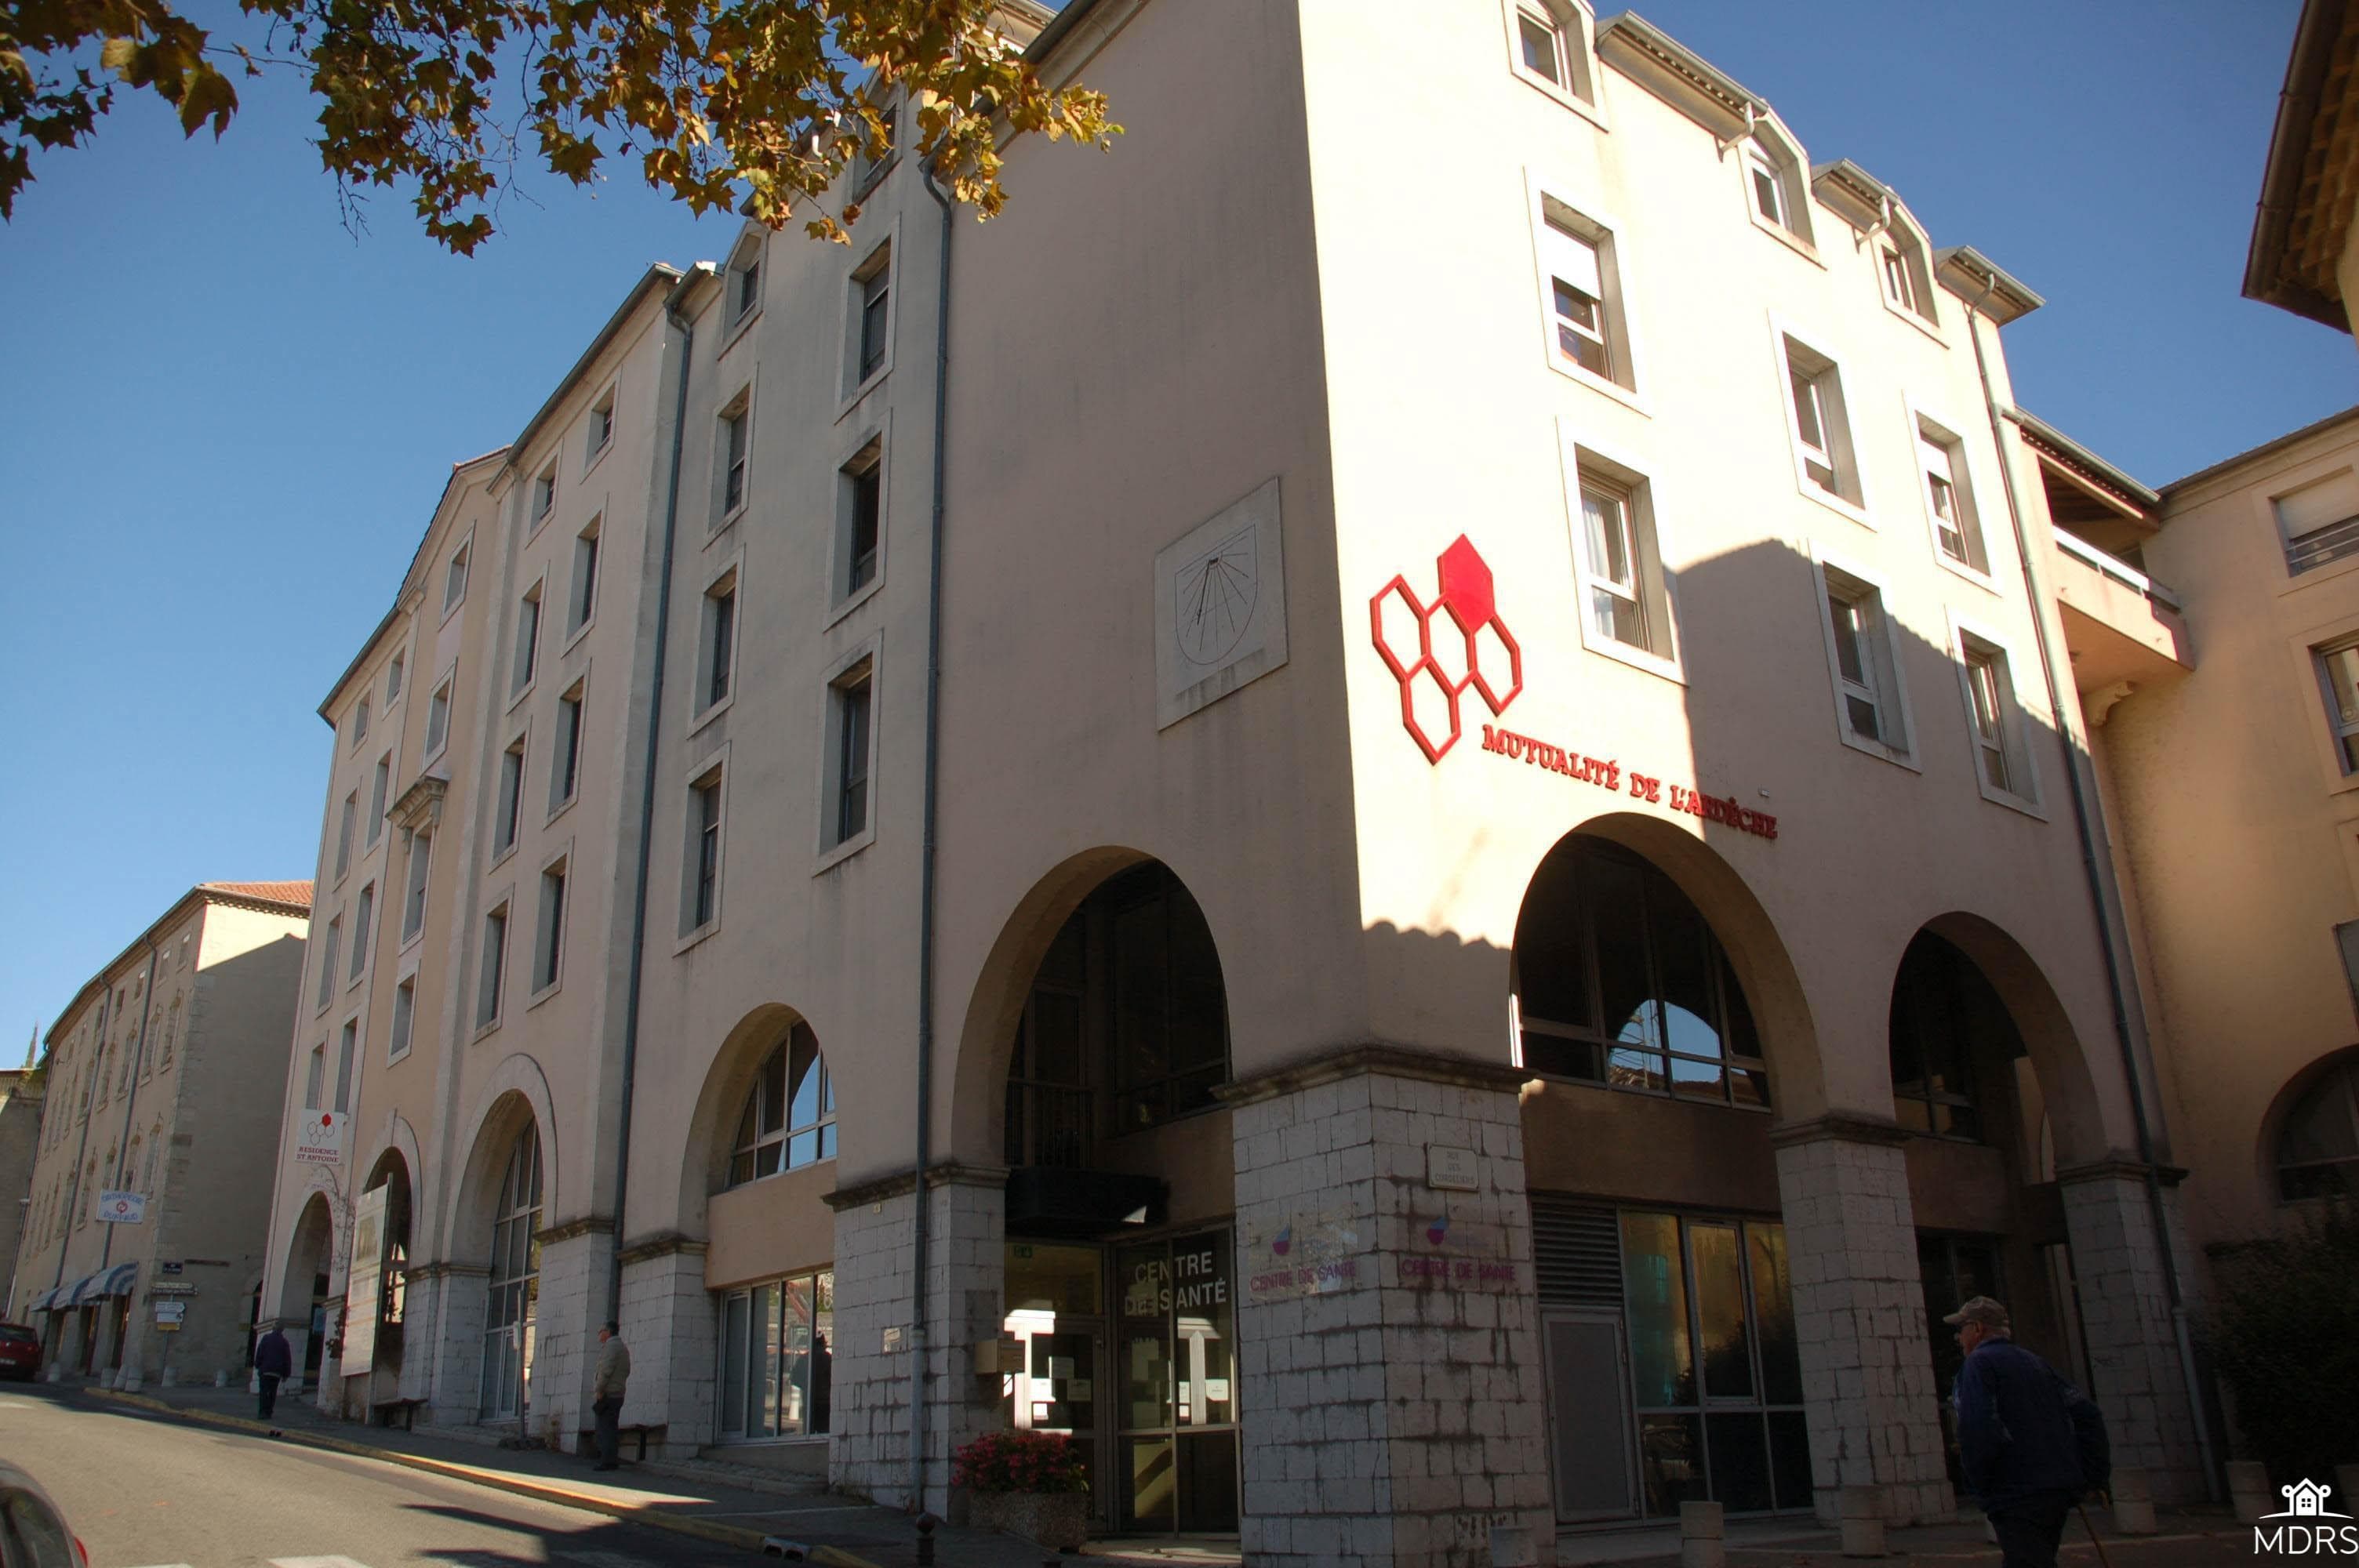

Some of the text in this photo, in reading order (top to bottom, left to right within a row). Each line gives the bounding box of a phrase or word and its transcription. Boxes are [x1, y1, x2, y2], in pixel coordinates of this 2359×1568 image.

[1481, 724, 1779, 840] MUTUALITÉ DE L'ARDÈCHE
[1136, 1251, 1212, 1283] CENTRE
[1250, 1271, 1293, 1292] CENTRE
[1298, 1266, 1314, 1285] DE
[1401, 1259, 1450, 1279] CENTRE
[1456, 1261, 1473, 1280] DE
[1125, 1277, 1227, 1316] DE SANTÉ
